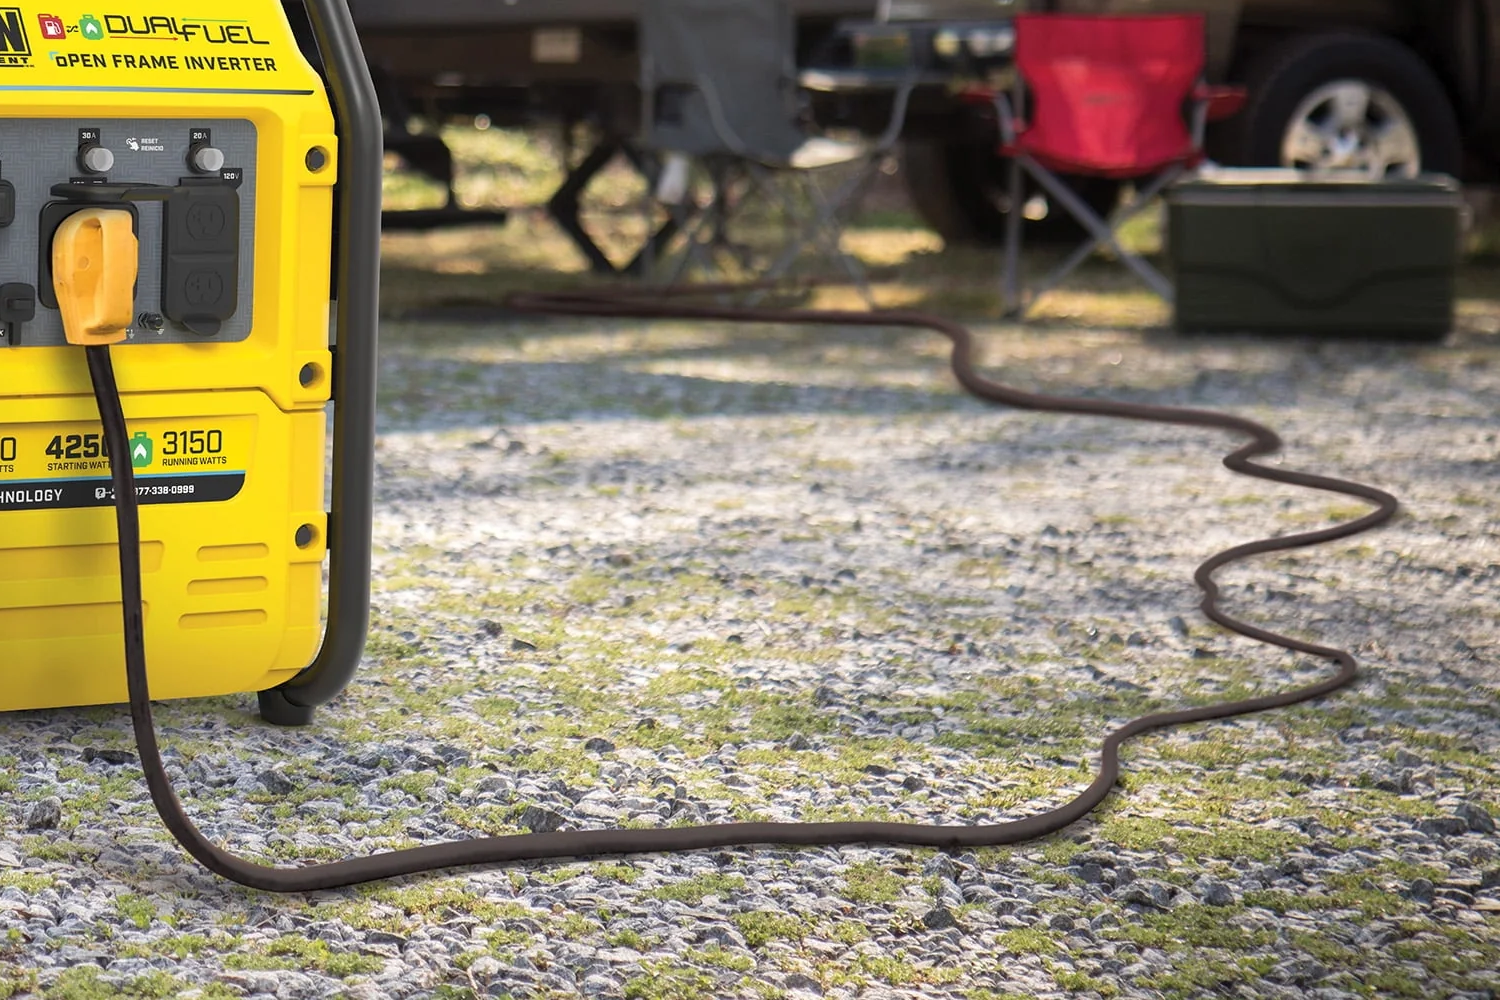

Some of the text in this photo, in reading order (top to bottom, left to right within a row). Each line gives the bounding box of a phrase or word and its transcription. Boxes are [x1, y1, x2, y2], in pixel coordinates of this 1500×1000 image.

[112, 54, 179, 69] FRAME
[185, 56, 277, 71] INVERTER
[162, 429, 222, 455] 3150
[47, 460, 111, 471] STARTING WATT
[162, 456, 227, 466] RUNNING WATTS
